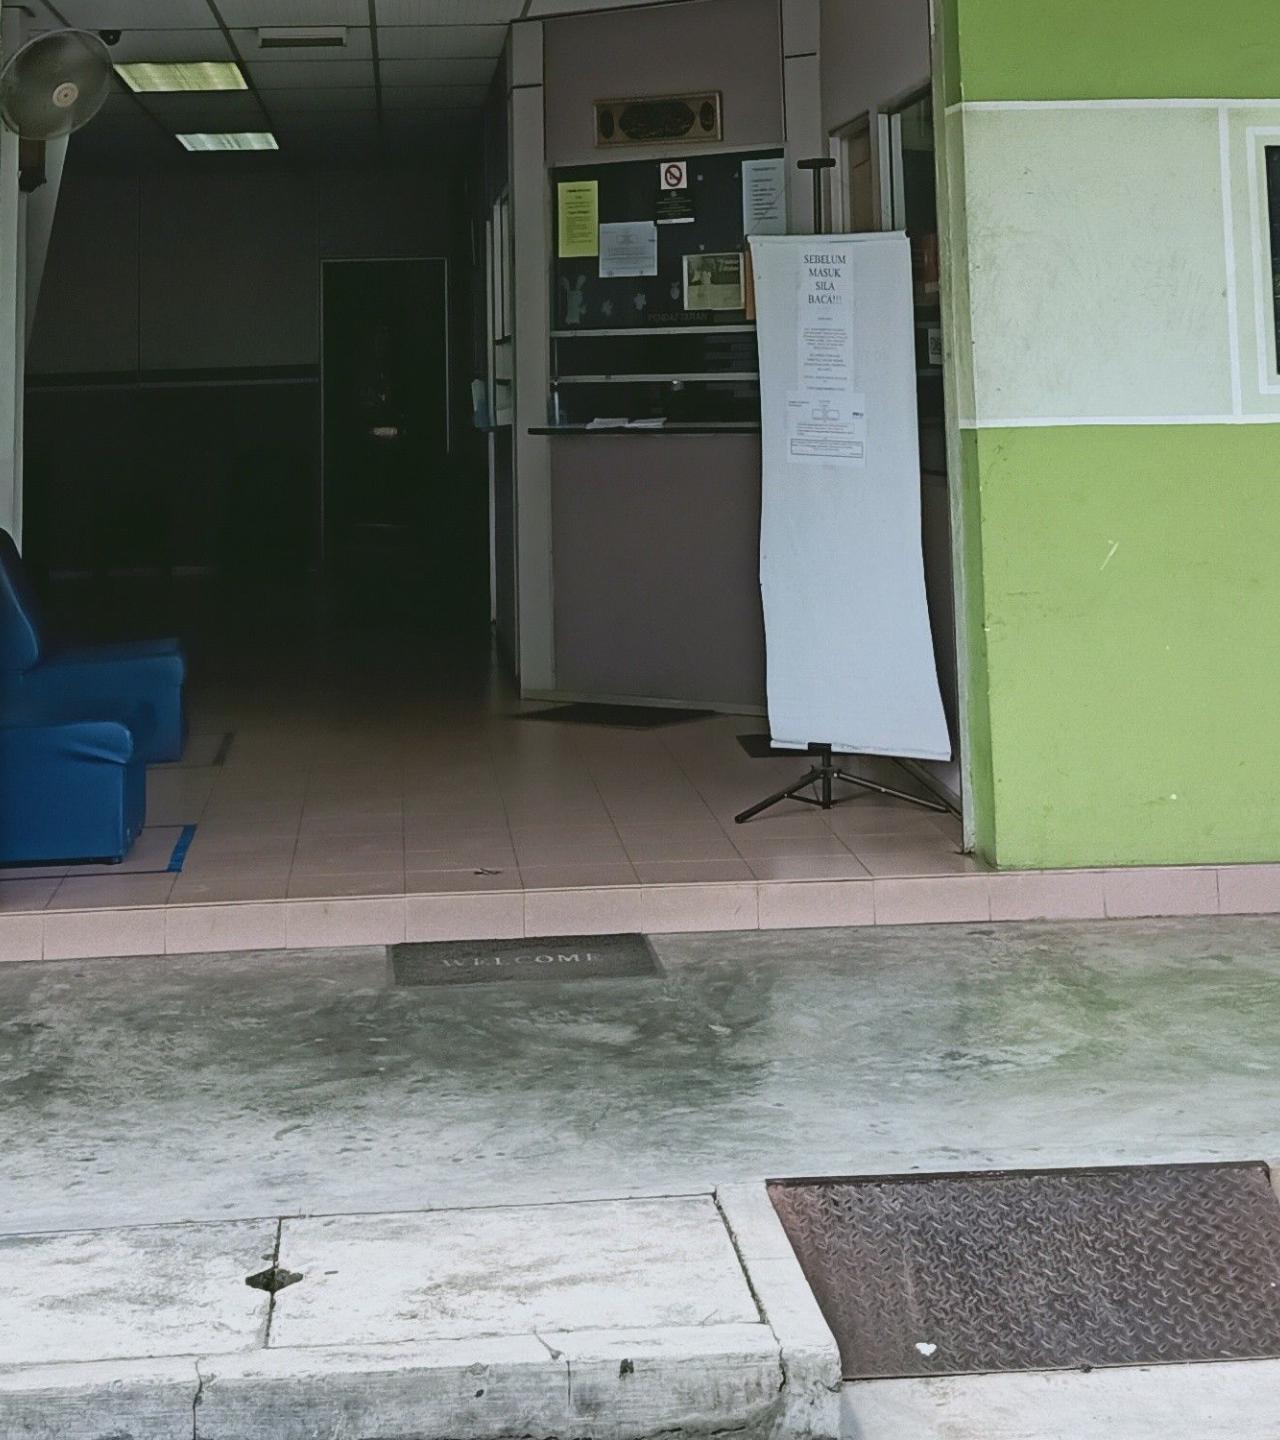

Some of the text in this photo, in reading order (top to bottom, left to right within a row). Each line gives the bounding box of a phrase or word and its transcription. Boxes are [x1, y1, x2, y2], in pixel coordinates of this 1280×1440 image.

[803, 254, 847, 265] SEBELUM
[808, 267, 842, 278] MASUK
[815, 280, 836, 291] SILA
